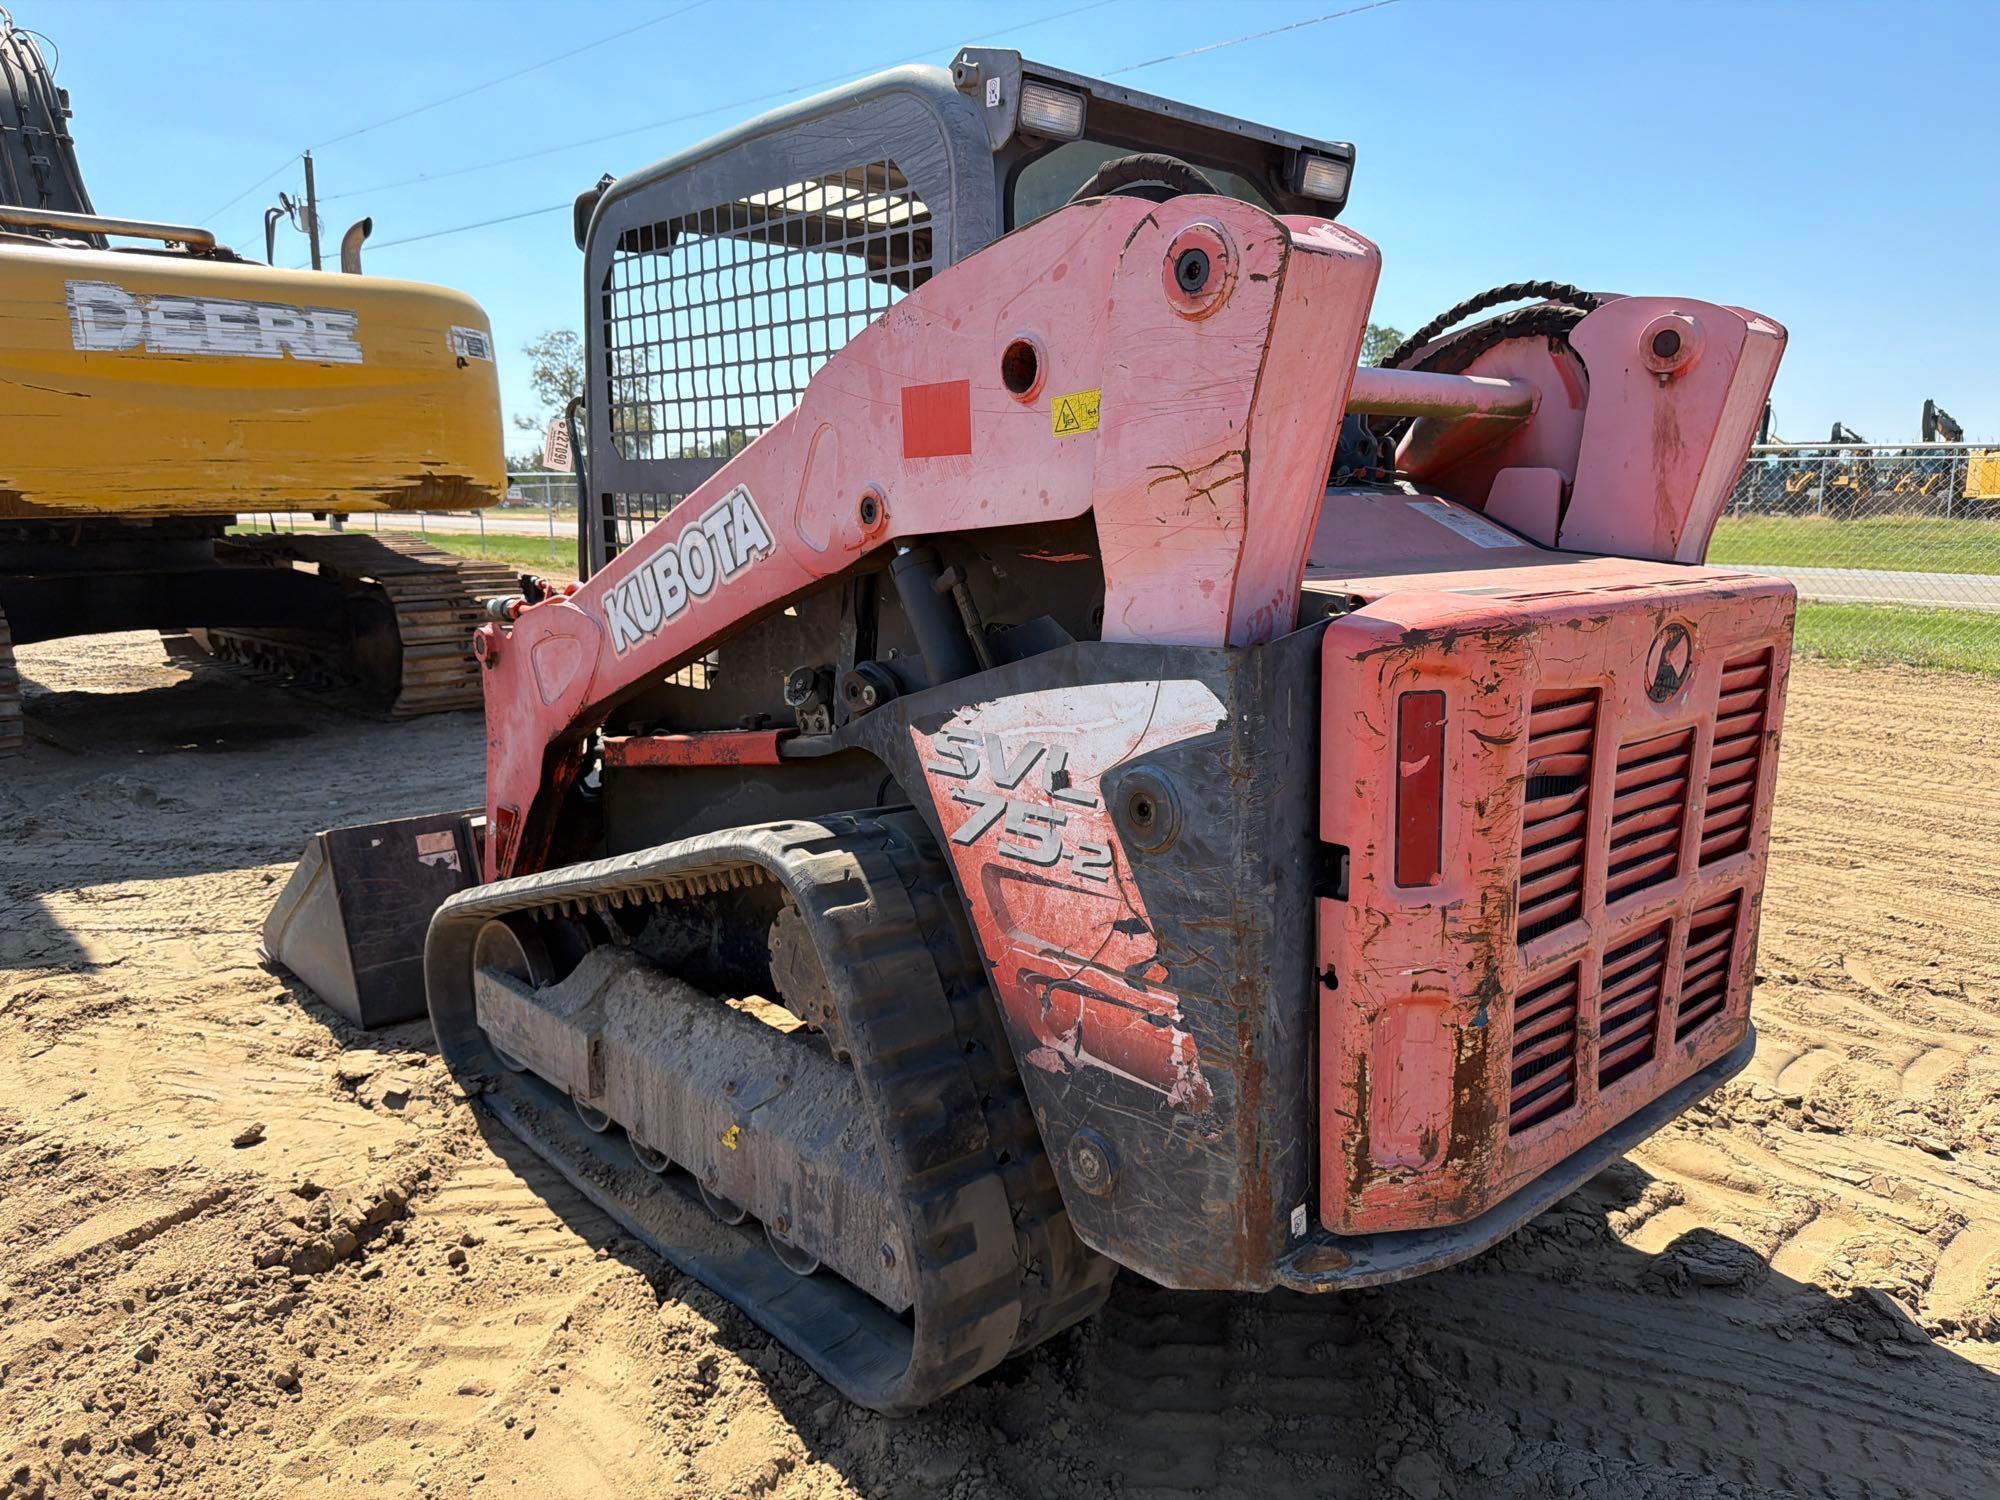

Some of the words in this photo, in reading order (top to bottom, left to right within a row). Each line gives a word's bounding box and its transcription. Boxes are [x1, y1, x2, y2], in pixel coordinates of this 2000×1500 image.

[66, 279, 363, 363] DEERE
[553, 430, 570, 465] 227090
[603, 490, 772, 654] KUBOTA
[927, 727, 1098, 809] SVL
[951, 787, 1112, 883] 75-2
